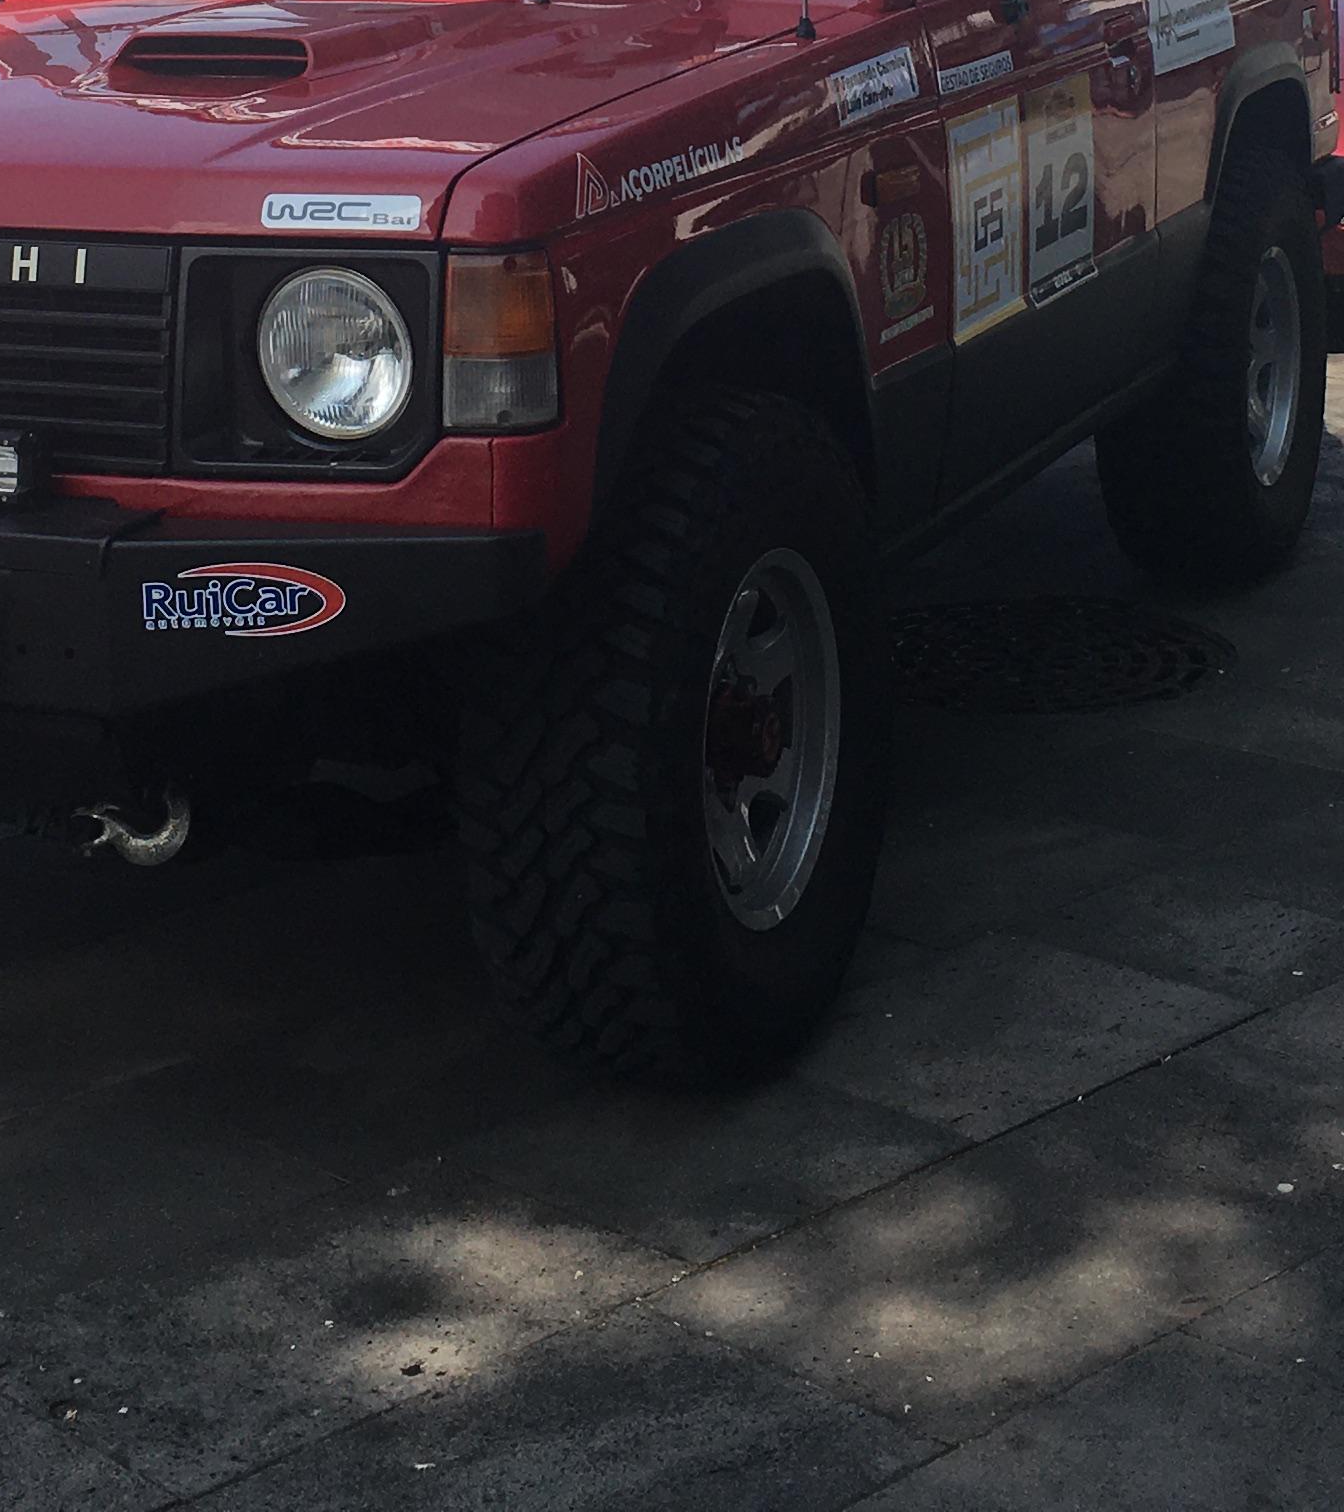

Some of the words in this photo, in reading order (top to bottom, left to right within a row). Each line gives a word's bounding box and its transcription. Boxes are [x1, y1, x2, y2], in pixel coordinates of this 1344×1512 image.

[621, 136, 744, 202] AÇORPELÍCULAS
[267, 201, 371, 221] WRC
[372, 213, 415, 225] Bar
[1036, 152, 1088, 252] 12
[142, 579, 309, 620] RuiCar
